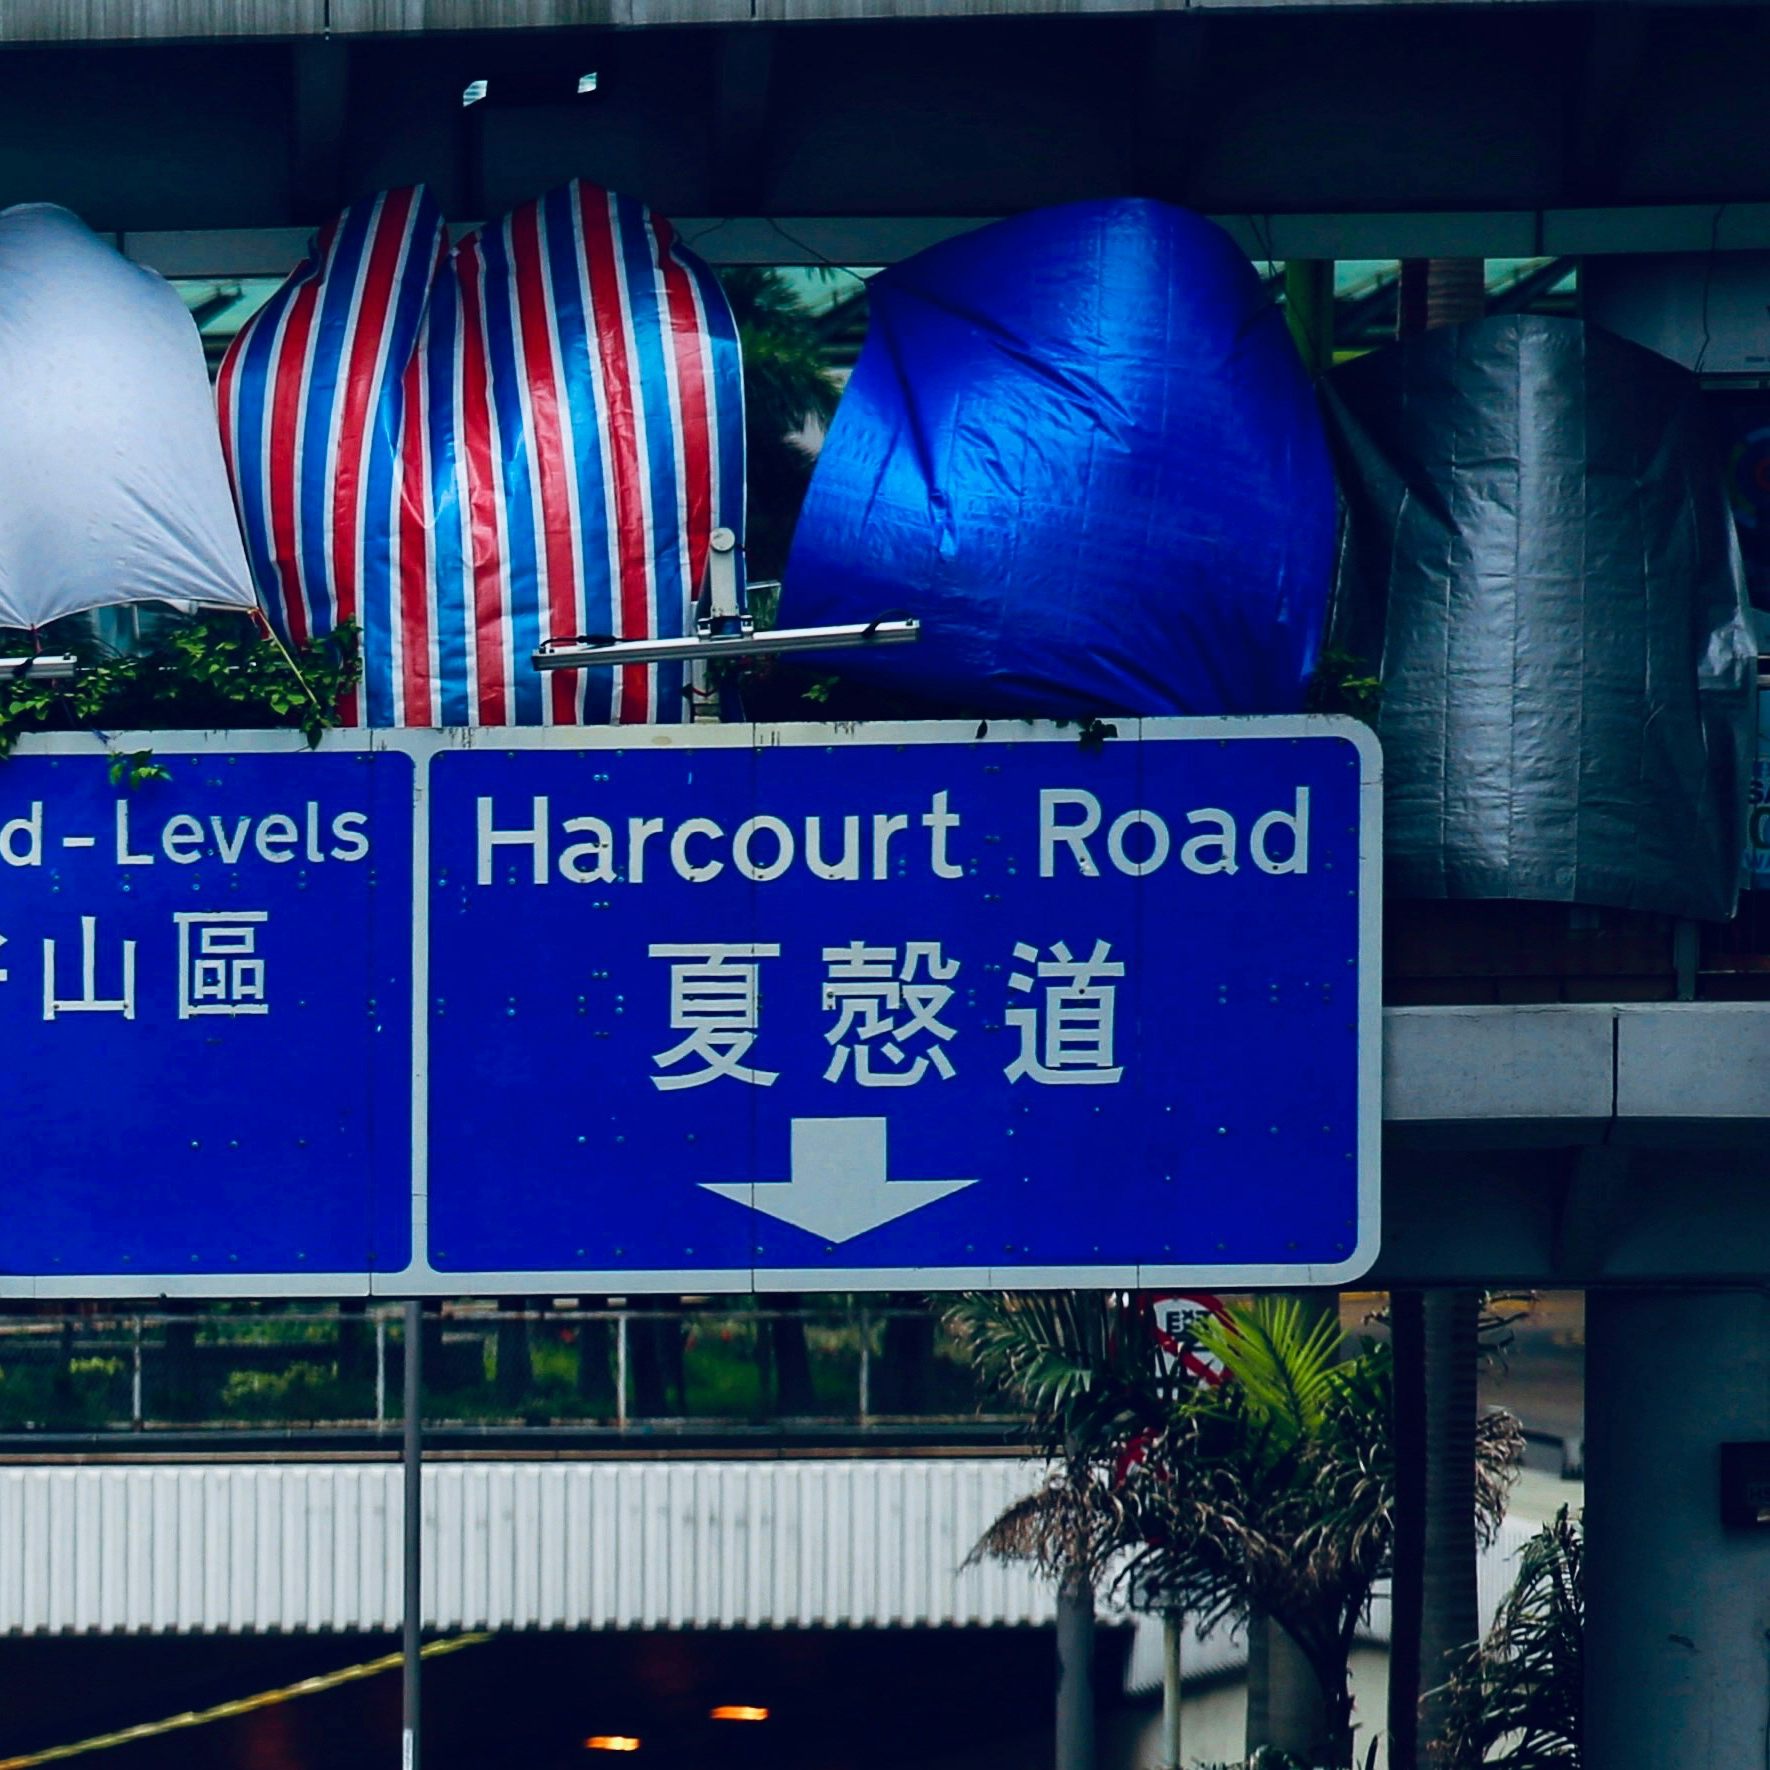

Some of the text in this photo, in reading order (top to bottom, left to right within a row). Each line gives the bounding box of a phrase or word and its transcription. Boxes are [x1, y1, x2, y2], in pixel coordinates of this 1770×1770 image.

[477, 787, 1309, 886] Harcourt Road
[648, 939, 1126, 1091] 夏慤道
